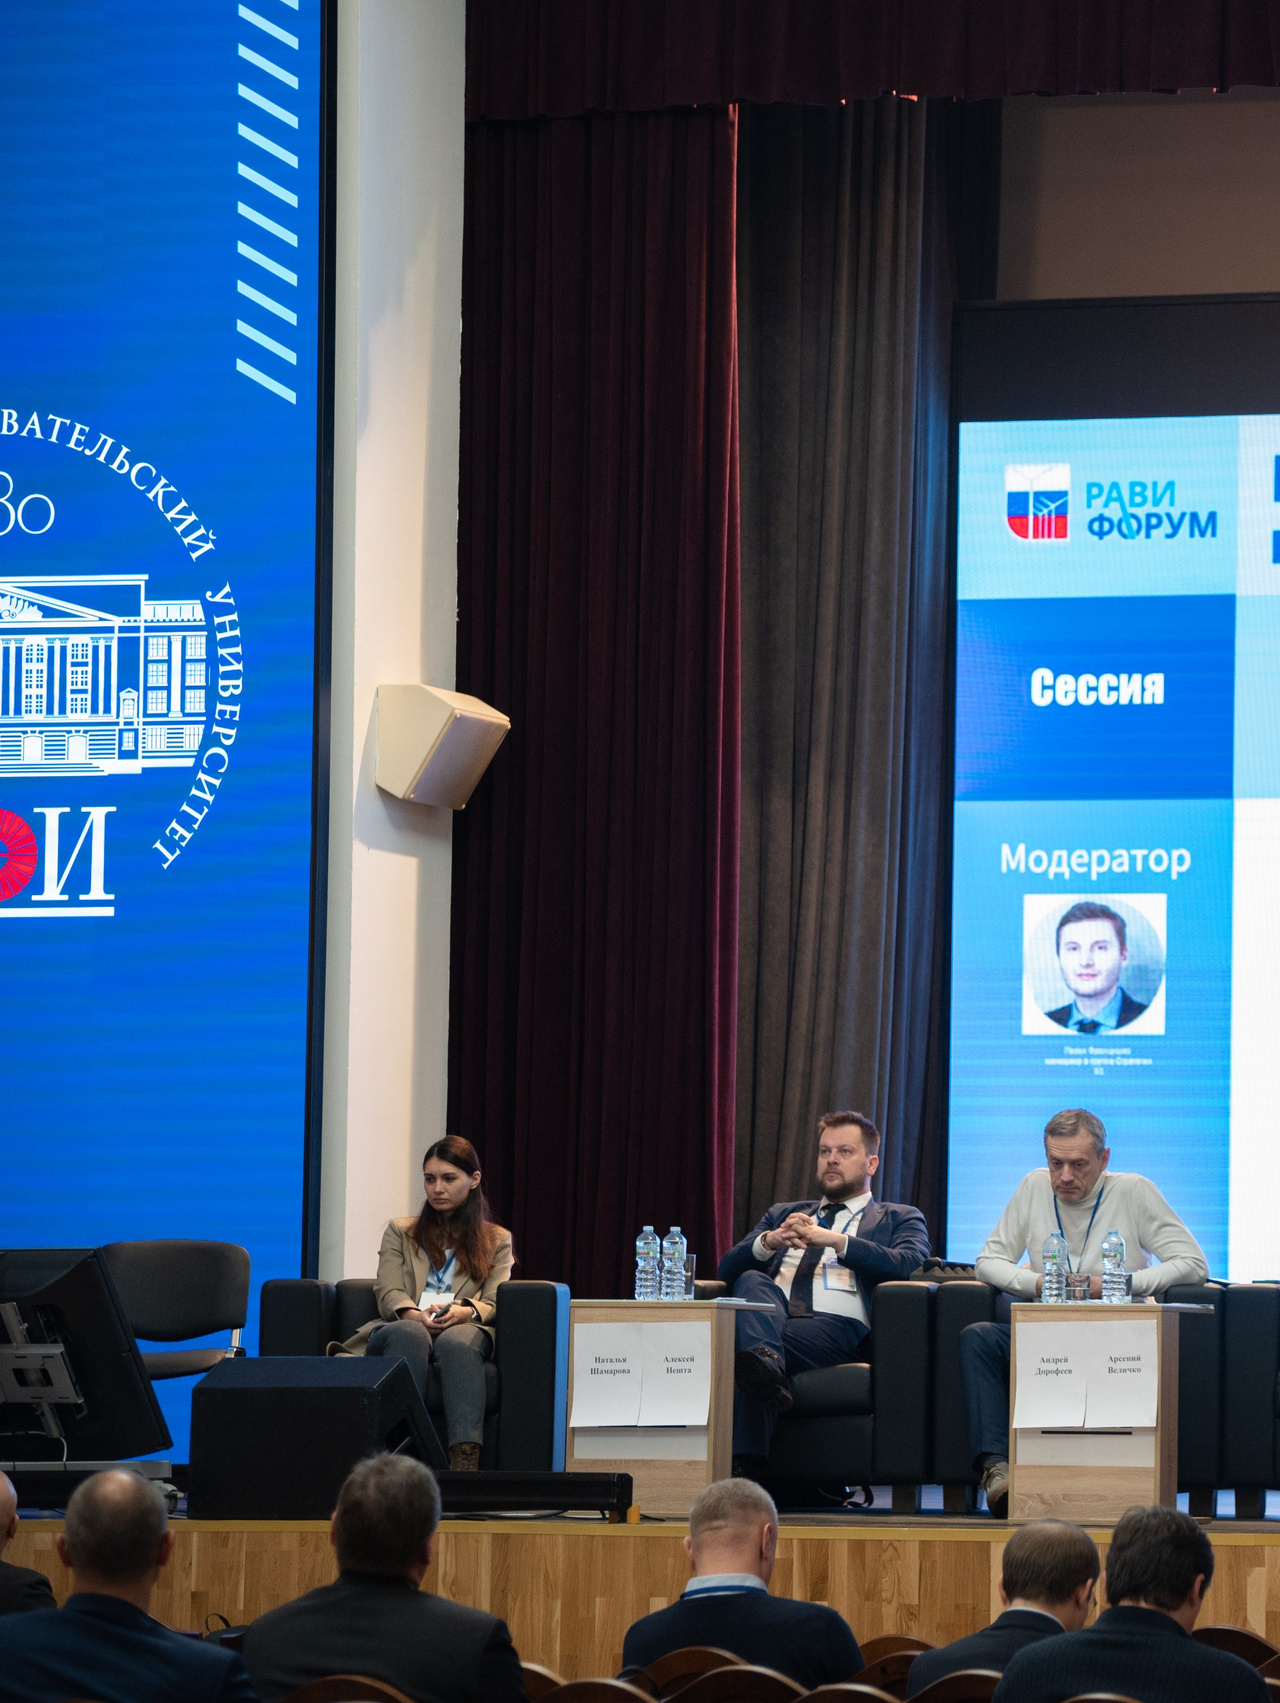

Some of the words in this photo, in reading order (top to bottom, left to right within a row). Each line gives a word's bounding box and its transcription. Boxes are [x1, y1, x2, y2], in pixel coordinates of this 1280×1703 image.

[1086, 480, 1176, 510] РАВИ
[1087, 507, 1218, 541] ФОРУМ
[1030, 667, 1165, 706] Сессия
[152, 581, 243, 869] УНИВЕРСИТЕТ
[1000, 841, 1192, 881] Модератор
[590, 1368, 630, 1376] Шамарова
[1035, 1368, 1072, 1376] Дорофеев
[1040, 1356, 1068, 1364] Андрей
